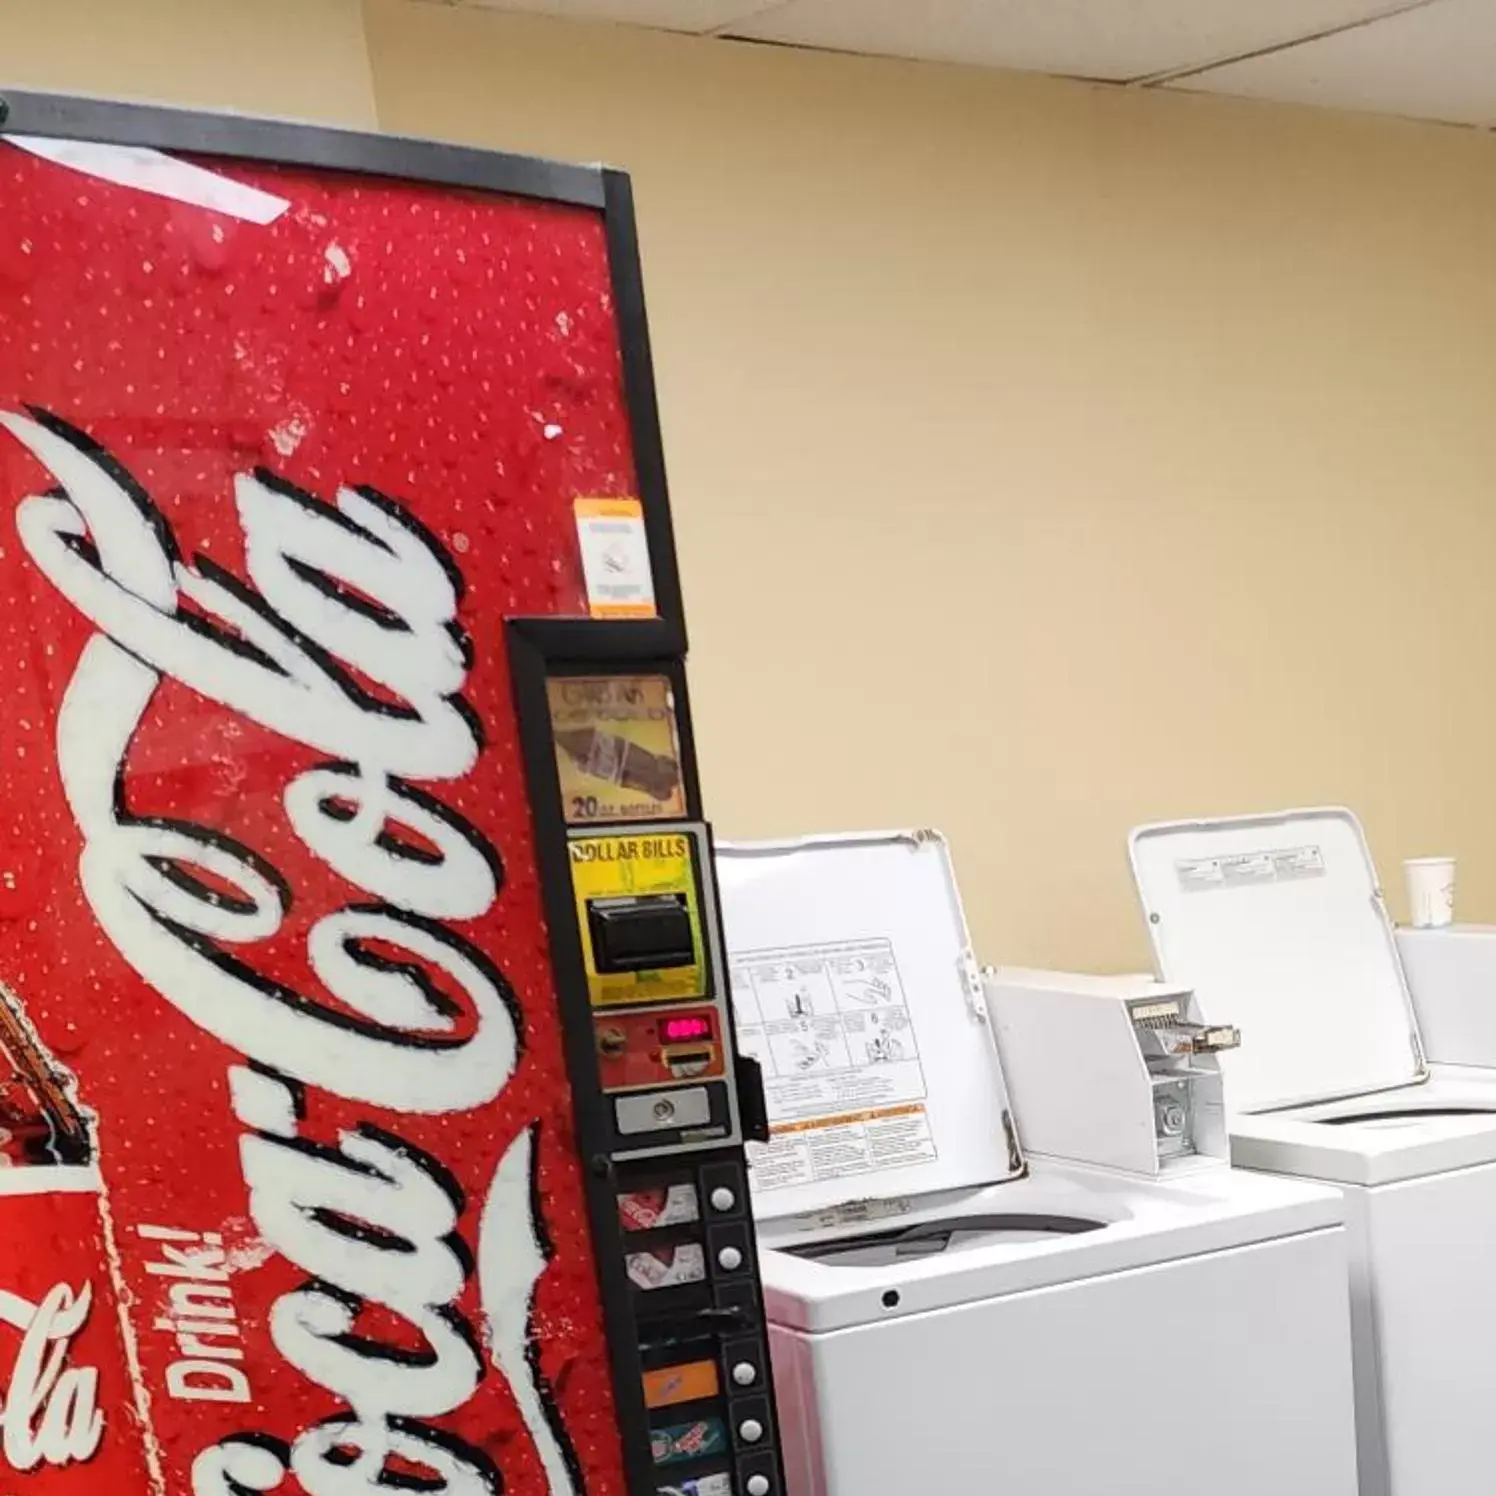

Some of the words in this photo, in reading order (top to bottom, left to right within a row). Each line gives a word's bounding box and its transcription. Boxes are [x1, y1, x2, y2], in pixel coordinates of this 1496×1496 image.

[572, 795, 597, 818] 20
[572, 840, 639, 864] DOLLAR
[641, 838, 686, 859] BILLS
[137, 1223, 253, 1403] Drink!
